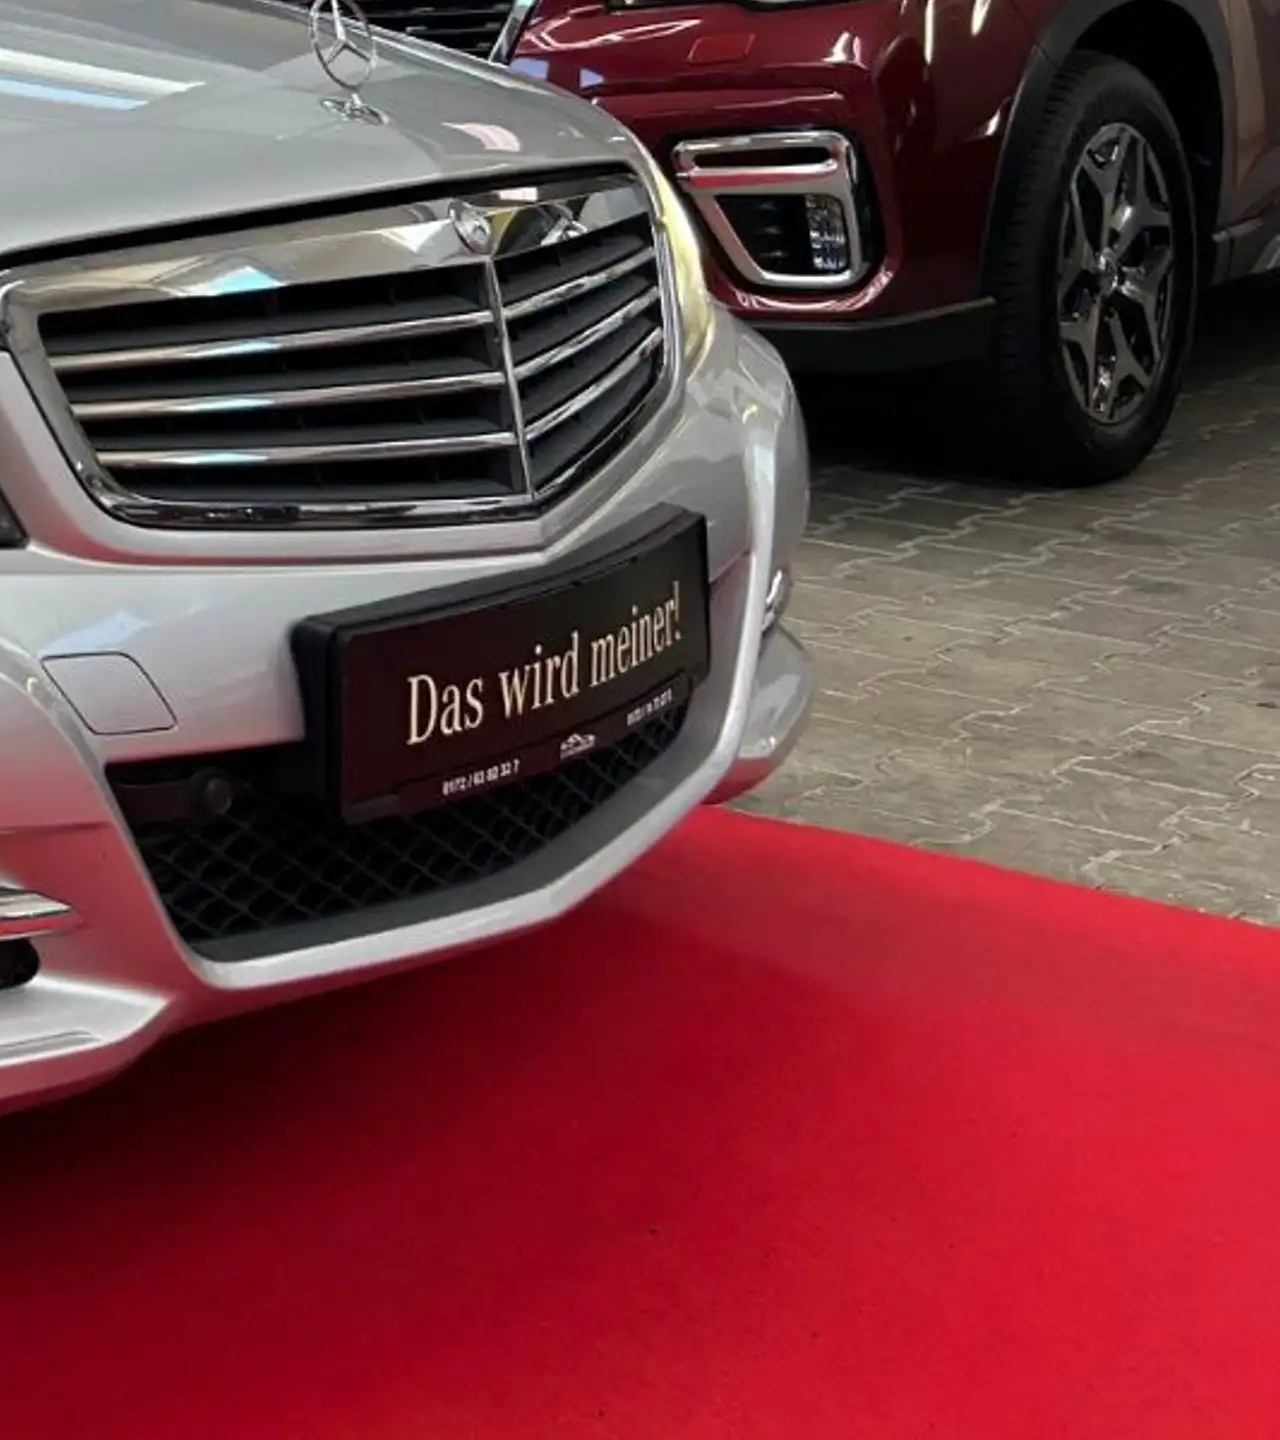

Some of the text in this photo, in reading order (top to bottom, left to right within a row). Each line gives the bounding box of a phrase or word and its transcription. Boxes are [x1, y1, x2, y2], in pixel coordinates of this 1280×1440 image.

[406, 673, 484, 746] Das
[499, 631, 580, 720] wird
[590, 580, 683, 687] meiner!
